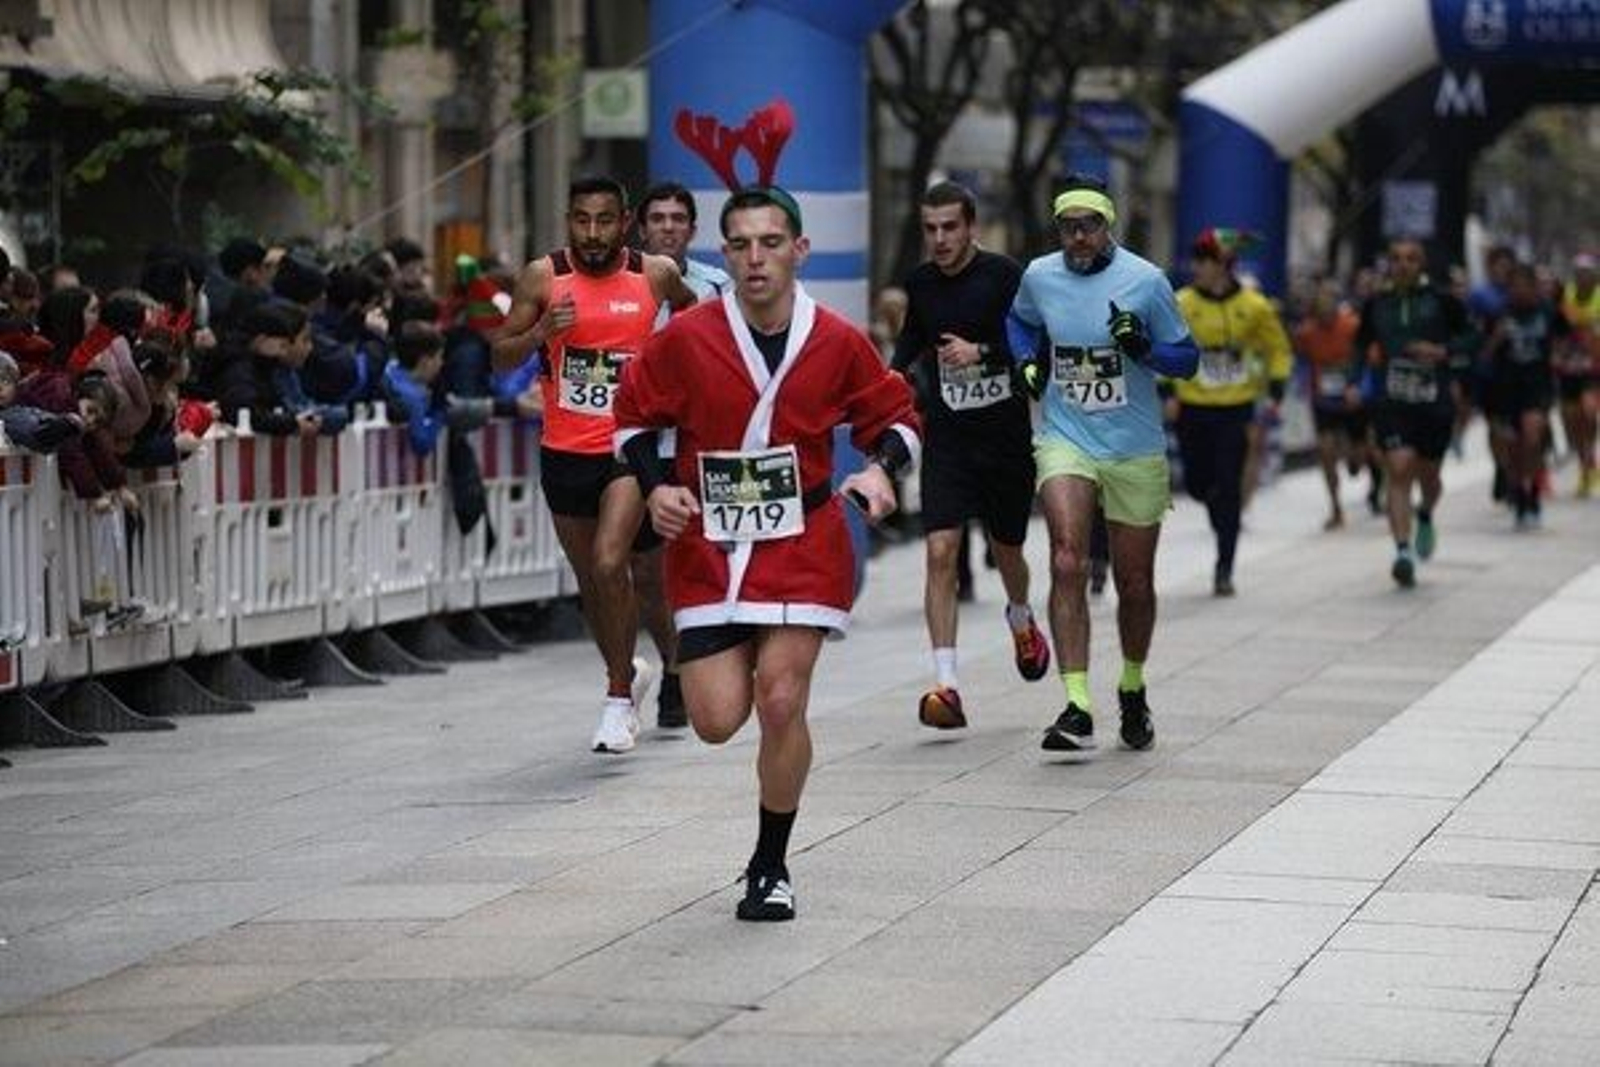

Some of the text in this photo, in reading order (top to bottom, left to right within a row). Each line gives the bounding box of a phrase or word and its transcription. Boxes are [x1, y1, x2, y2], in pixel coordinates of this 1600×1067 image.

[569, 382, 619, 408] 38
[946, 379, 1003, 403] 1746
[713, 503, 785, 531] 1719
